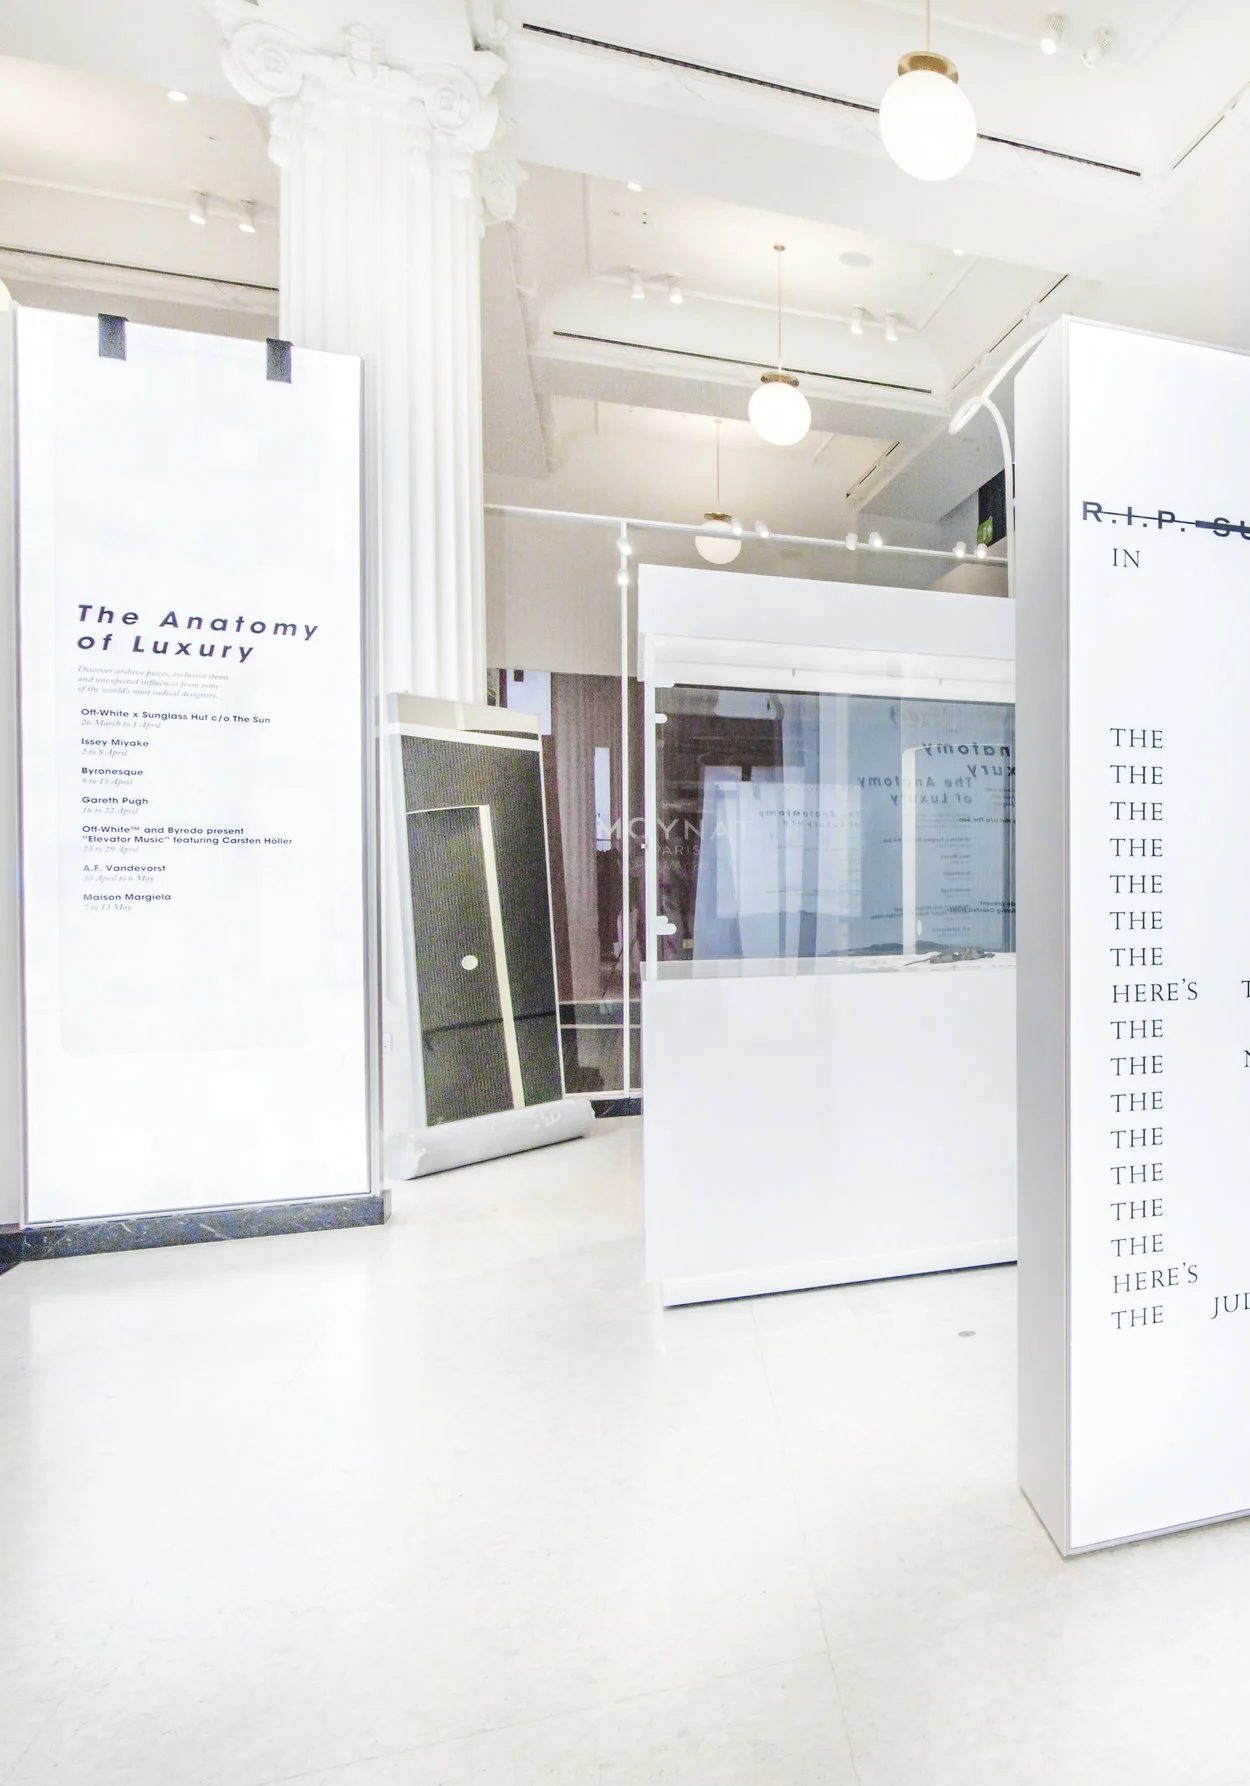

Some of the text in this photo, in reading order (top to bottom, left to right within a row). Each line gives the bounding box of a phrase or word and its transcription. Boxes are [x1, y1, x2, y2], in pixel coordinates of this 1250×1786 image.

[1082, 500, 1185, 533] R.I.P.
[1113, 548, 1140, 568] IN
[78, 604, 318, 640] The Anatomy
[77, 634, 254, 663] of Luxury
[77, 665, 113, 674] Discover
[146, 670, 171, 678] pieces,
[208, 672, 229, 680] items
[95, 677, 139, 686] unexpected
[141, 678, 178, 687] influences
[179, 679, 200, 688] from
[77, 685, 86, 693] of
[181, 690, 218, 699] designers.
[80, 708, 129, 718] Off-White
[142, 711, 188, 720] Sunglass
[94, 719, 121, 727] March
[139, 721, 162, 729] April
[81, 737, 149, 748] Issey Miyake
[1110, 728, 1163, 748] THE
[106, 749, 128, 758] April
[81, 767, 144, 776] Byronesque
[1110, 765, 1163, 784] THE
[111, 778, 133, 787] April
[81, 796, 149, 806] Gareth Pugh
[116, 807, 139, 816] April
[1110, 802, 1162, 821] THE
[167, 827, 203, 835] Byredo
[173, 836, 219, 845] featuring
[264, 837, 293, 845] Höller
[1110, 838, 1162, 857] THE
[116, 846, 139, 855] April
[83, 864, 166, 872] A.F. Vandevorst
[95, 875, 118, 884] April
[136, 875, 155, 883] May
[1110, 875, 1162, 893] THE
[83, 893, 172, 902] Maison Margiela
[113, 903, 132, 912] May
[1110, 911, 1162, 930] THE
[1110, 948, 1162, 966] THE
[1111, 1019, 1163, 1039] THE
[1111, 1055, 1163, 1076] THE
[1111, 1091, 1163, 1112] THE
[1111, 1127, 1163, 1148] THE
[1111, 1163, 1163, 1185] THE
[1111, 1199, 1163, 1220] THE
[1111, 1234, 1163, 1257] THE
[1111, 1305, 1163, 1329] THE
